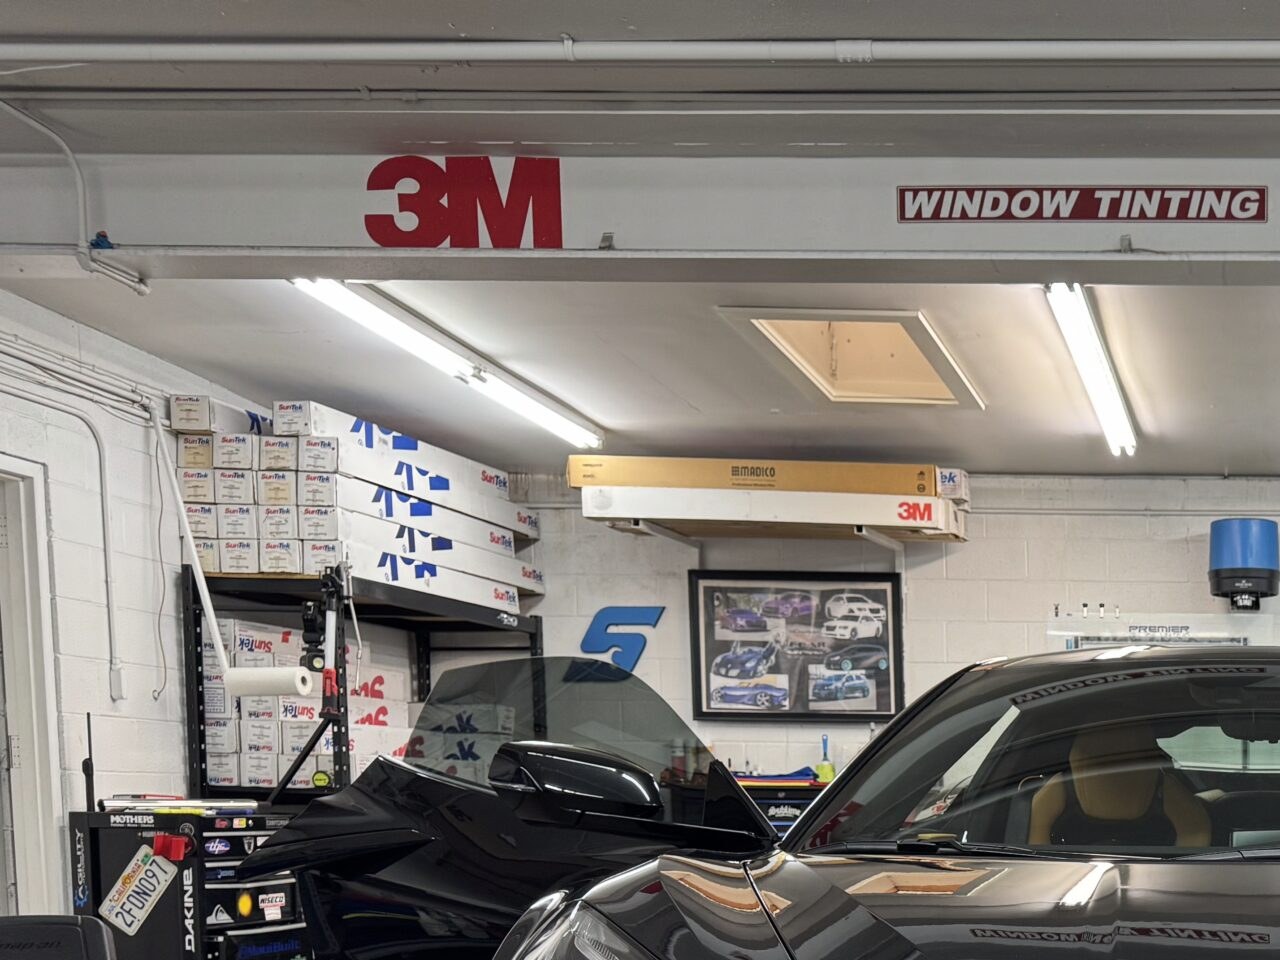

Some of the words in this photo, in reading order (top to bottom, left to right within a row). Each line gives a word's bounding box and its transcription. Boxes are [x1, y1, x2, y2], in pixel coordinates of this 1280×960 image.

[364, 155, 563, 248] 3M
[904, 190, 1080, 220] WINDOW
[1096, 190, 1260, 220] TINTING
[481, 470, 508, 488] SunTek
[897, 502, 932, 521] 3M
[489, 531, 513, 549] SunTek
[493, 588, 518, 604] SunTek
[238, 636, 273, 653] SunTek
[282, 703, 315, 720] SunTek
[110, 815, 154, 823] MOTHERS
